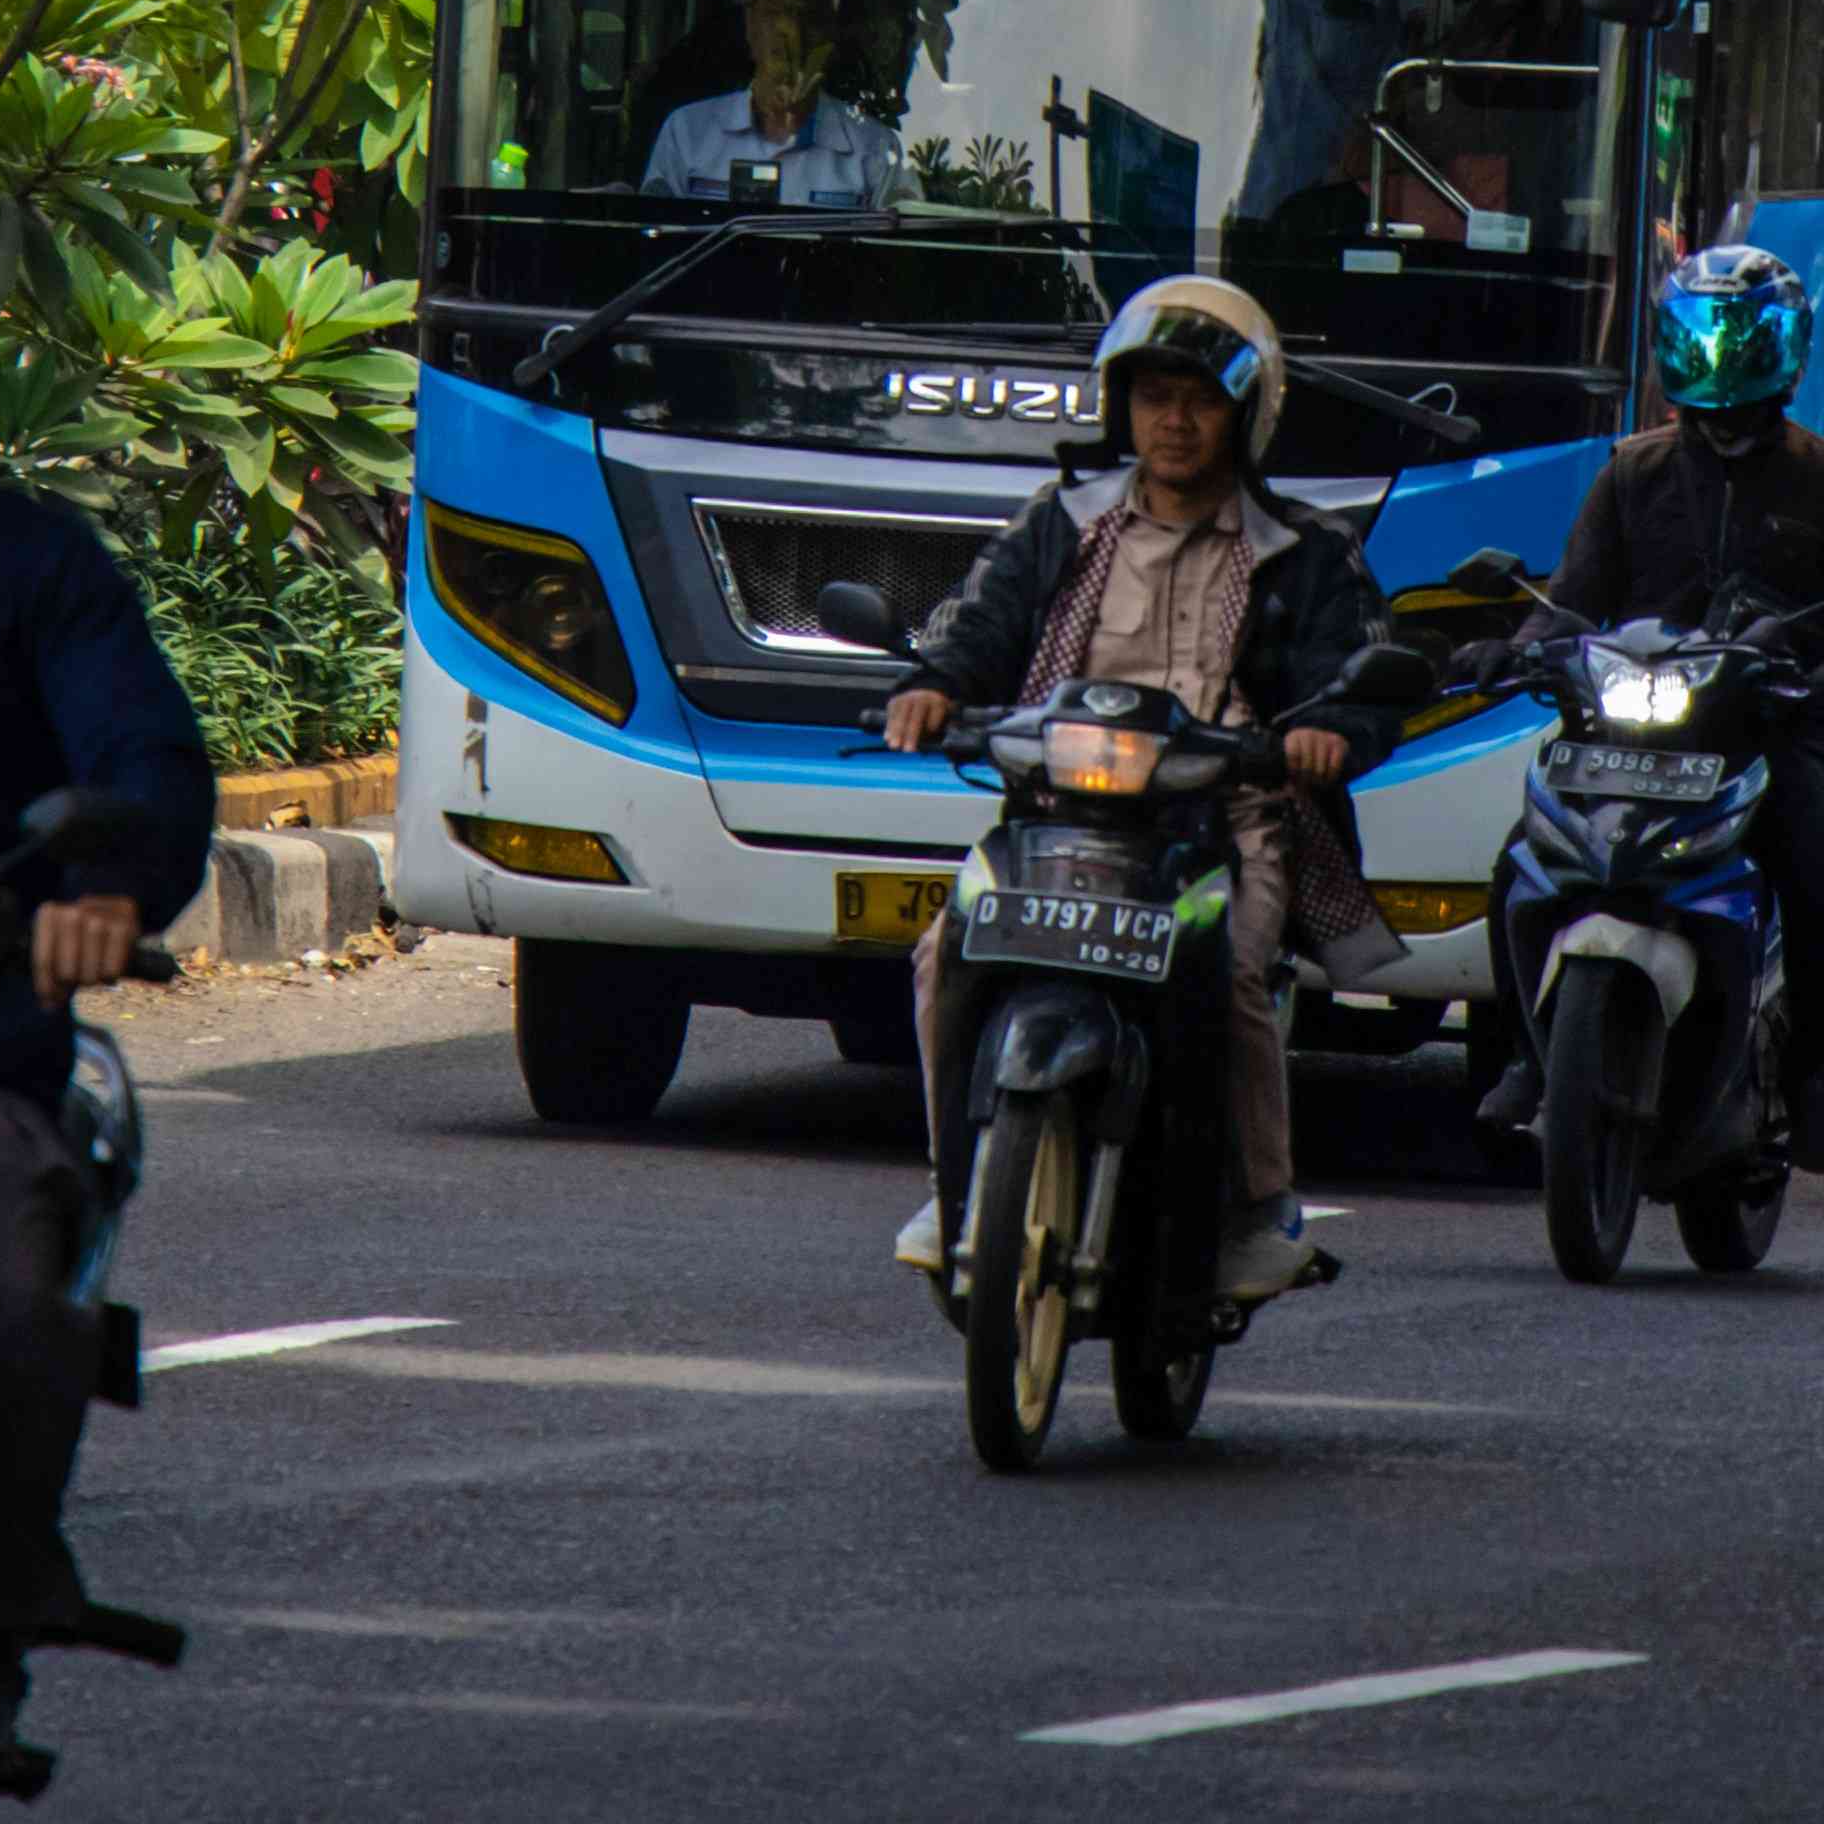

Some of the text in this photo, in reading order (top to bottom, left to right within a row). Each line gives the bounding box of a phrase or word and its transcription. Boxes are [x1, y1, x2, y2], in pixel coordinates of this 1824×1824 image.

[883, 370, 1107, 426] ISUZU
[1555, 746, 1717, 777] D 5096 KS
[843, 879, 865, 921] D
[978, 894, 1172, 943] D 3797 VCP
